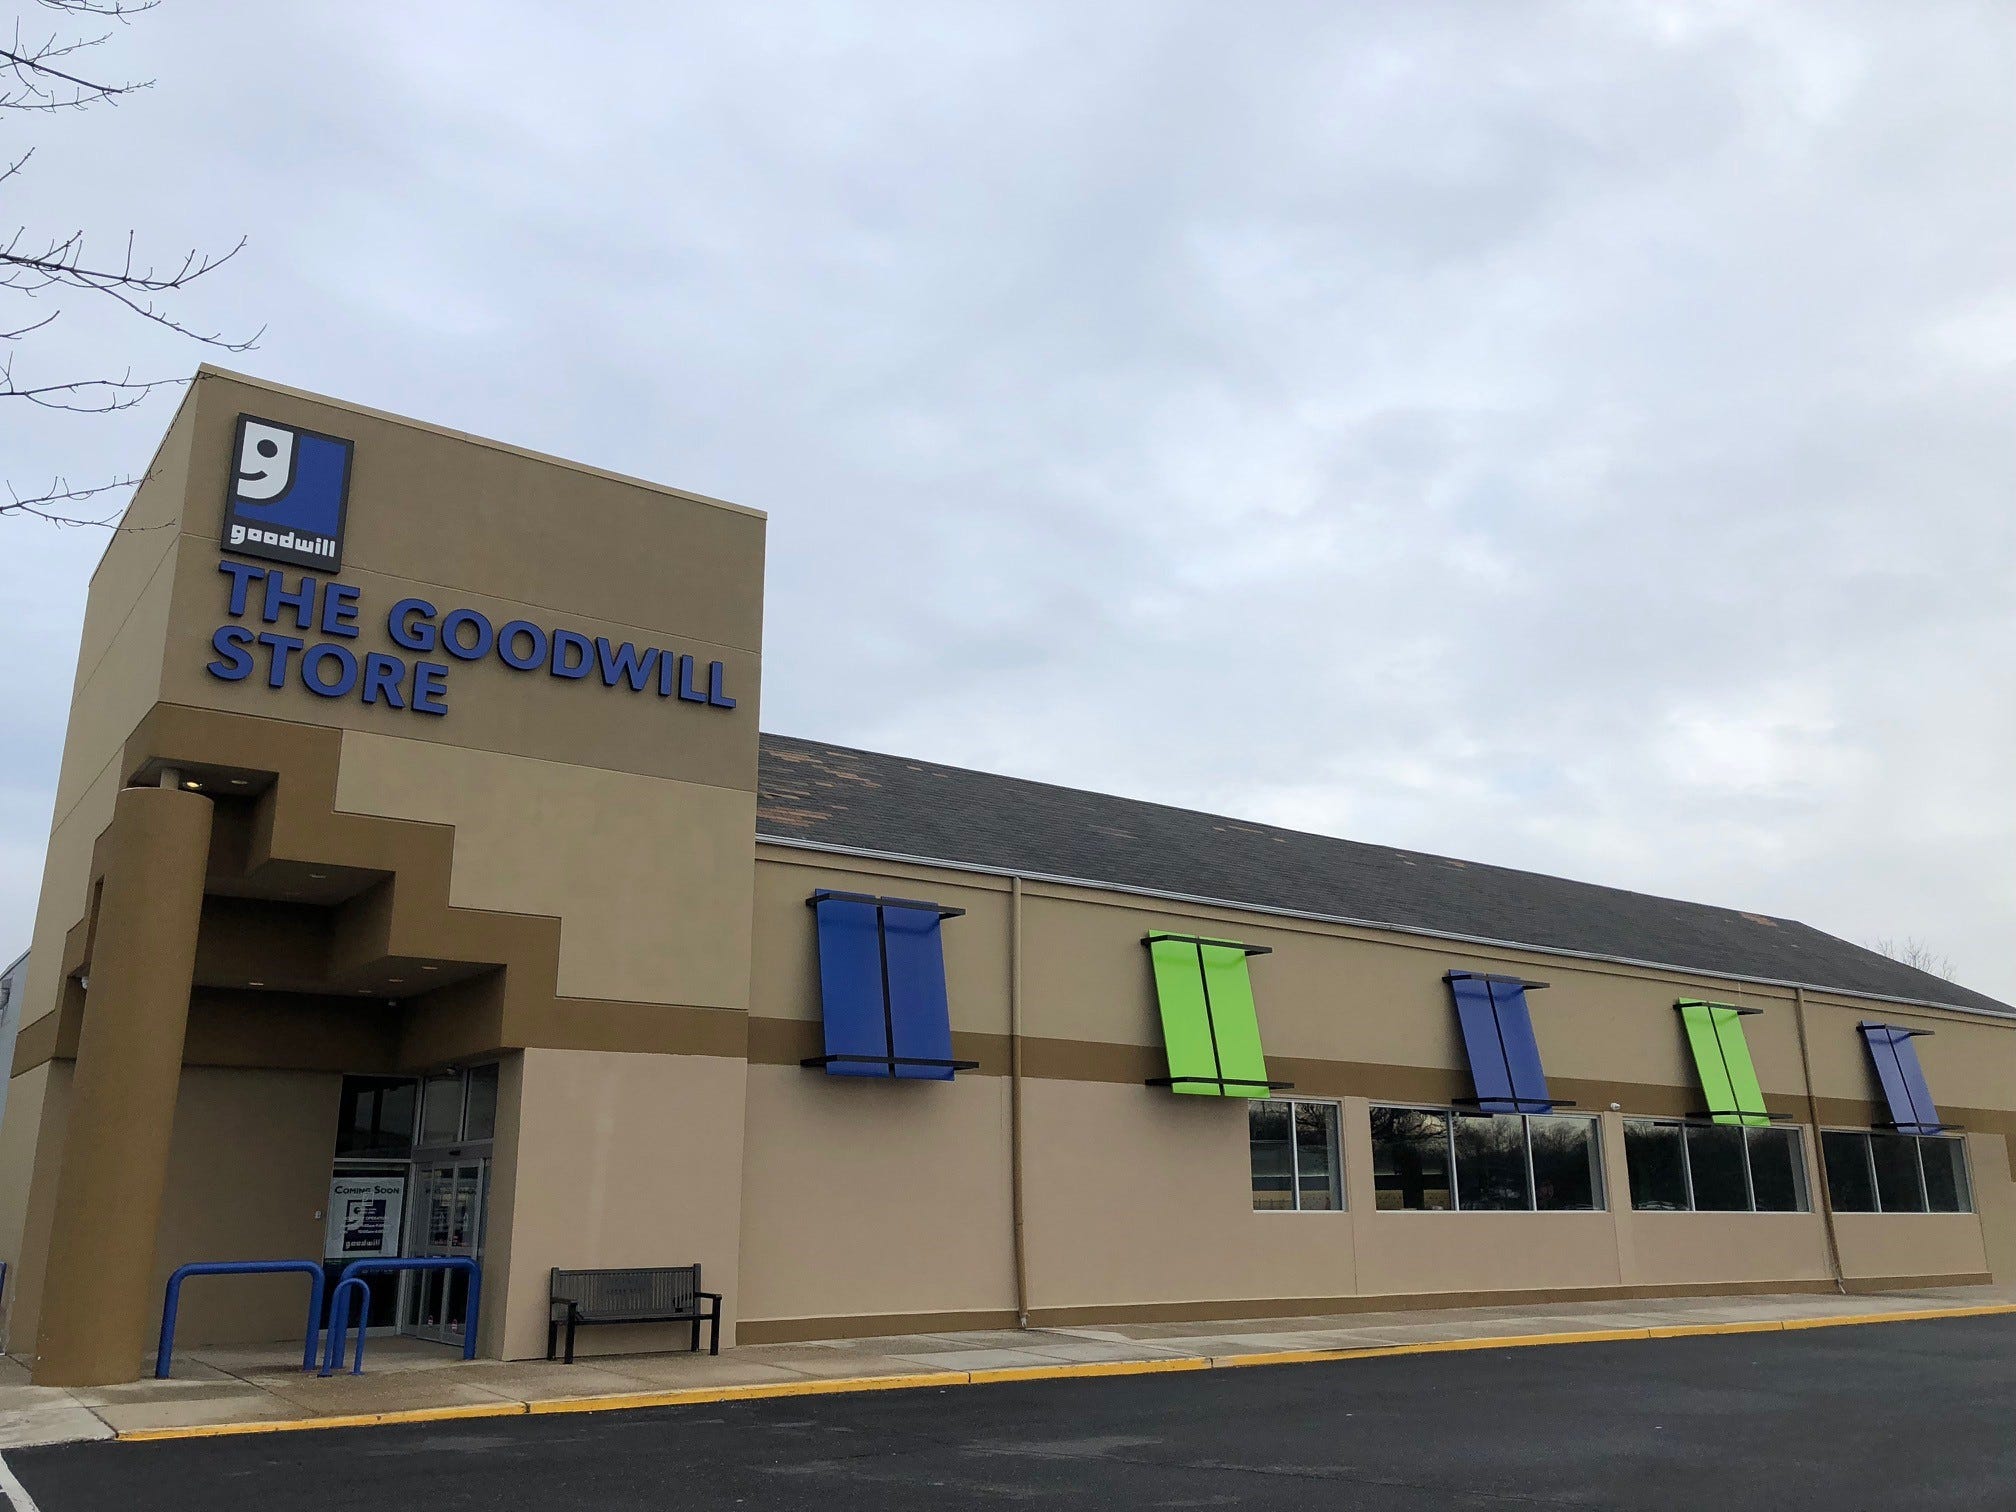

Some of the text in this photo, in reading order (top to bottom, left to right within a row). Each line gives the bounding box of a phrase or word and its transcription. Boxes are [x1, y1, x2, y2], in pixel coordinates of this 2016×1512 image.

[230, 523, 336, 558] goodwill
[218, 559, 737, 709] THE GOODWILL
[207, 625, 449, 716] STORE
[374, 1186, 399, 1194] SOON
